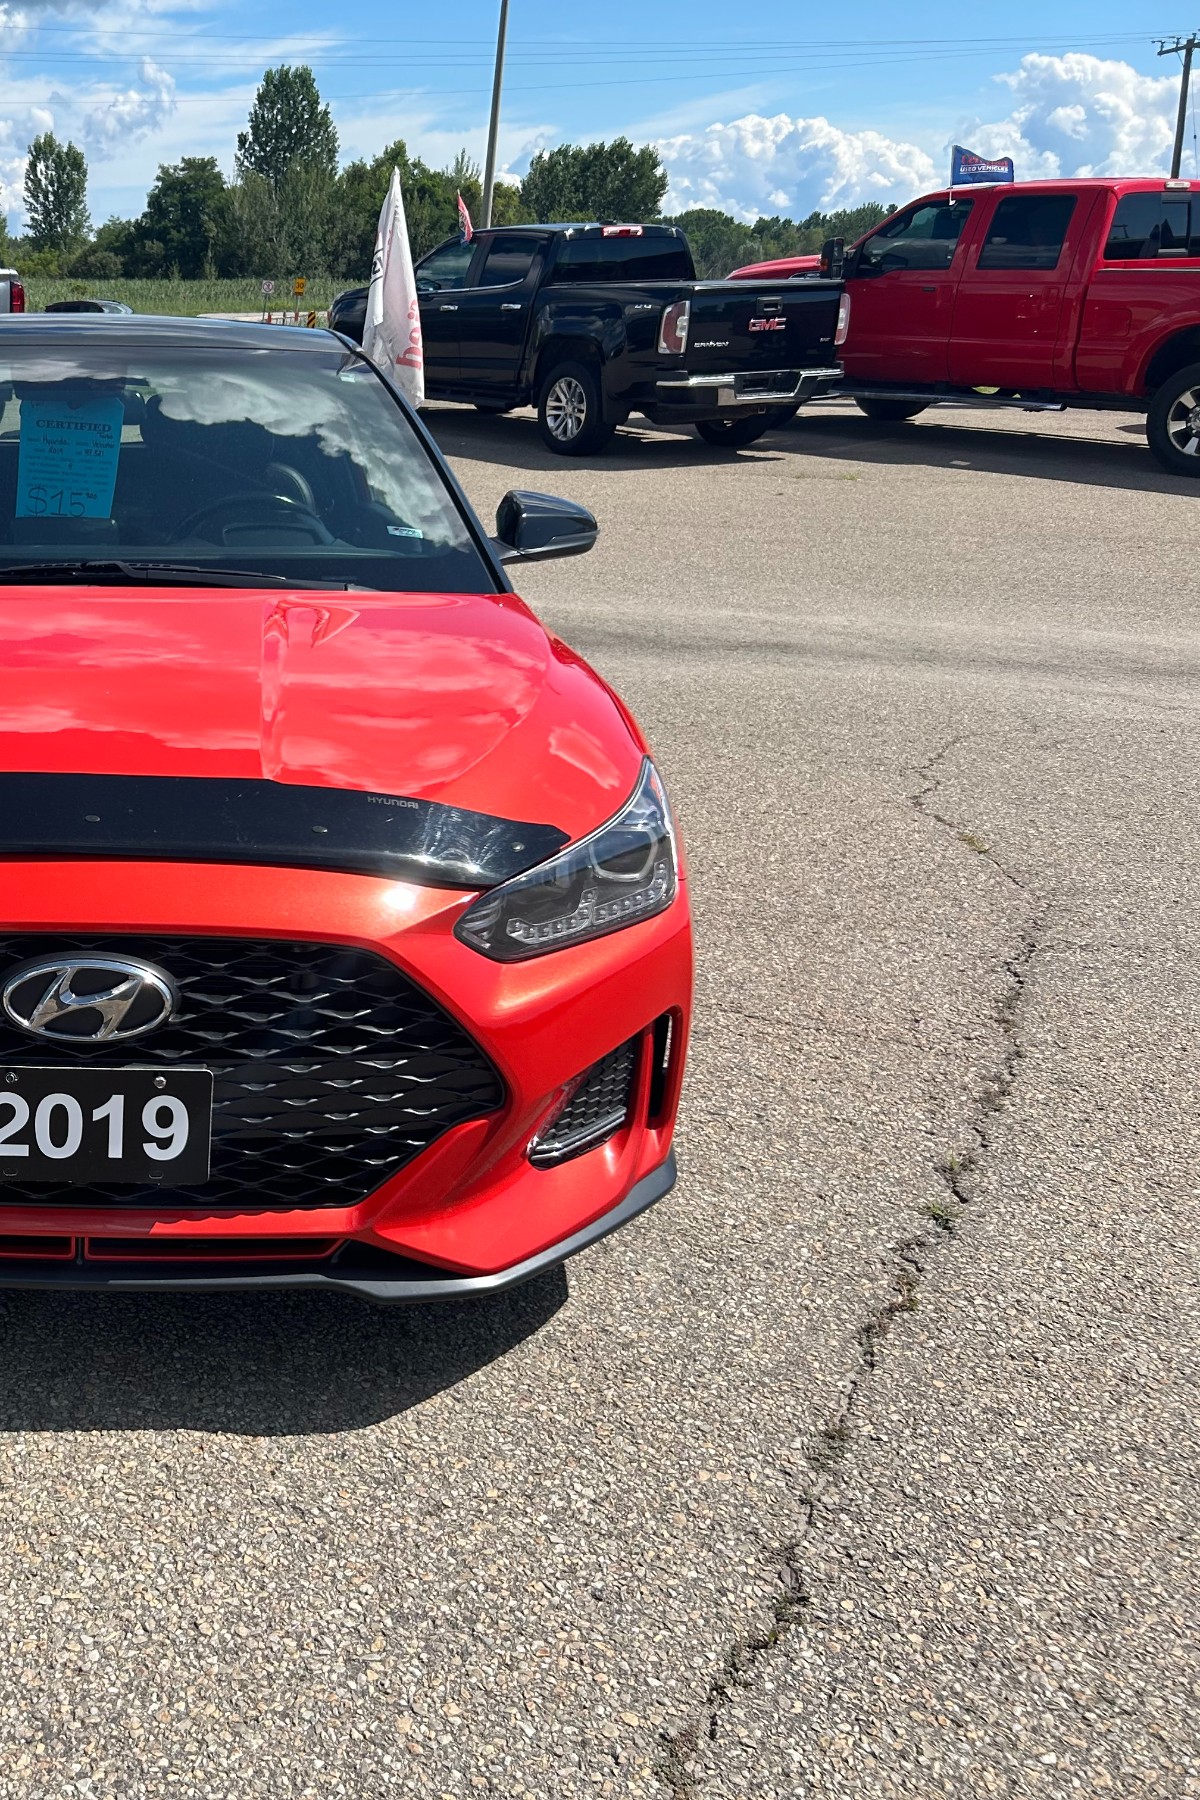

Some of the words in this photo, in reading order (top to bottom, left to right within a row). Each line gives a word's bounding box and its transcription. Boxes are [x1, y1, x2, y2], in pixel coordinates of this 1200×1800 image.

[749, 317, 786, 331] GMC
[36, 420, 112, 432] CERTIFIED
[367, 796, 419, 809] HYUNDAI
